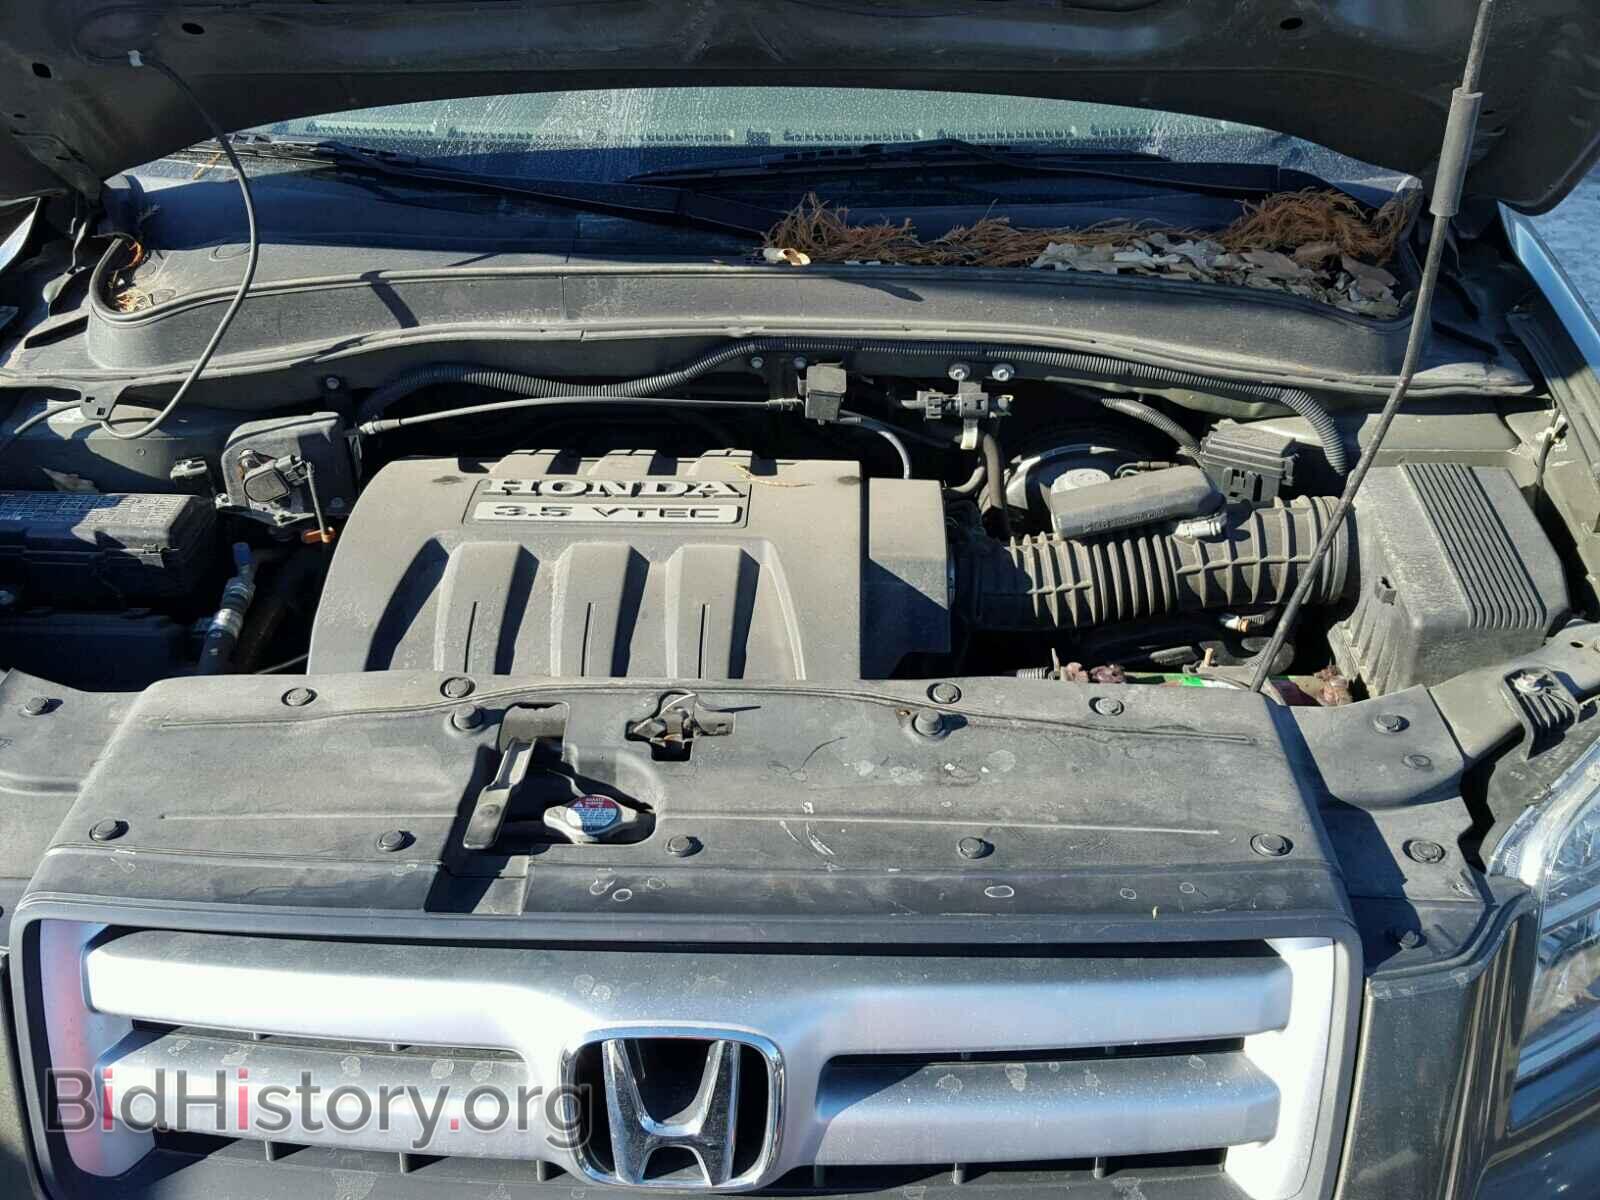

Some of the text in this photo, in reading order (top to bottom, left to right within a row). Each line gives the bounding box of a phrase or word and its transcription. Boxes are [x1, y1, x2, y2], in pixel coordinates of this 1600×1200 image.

[482, 480, 747, 498] HONDA
[494, 505, 721, 519] 3.5 VTEC
